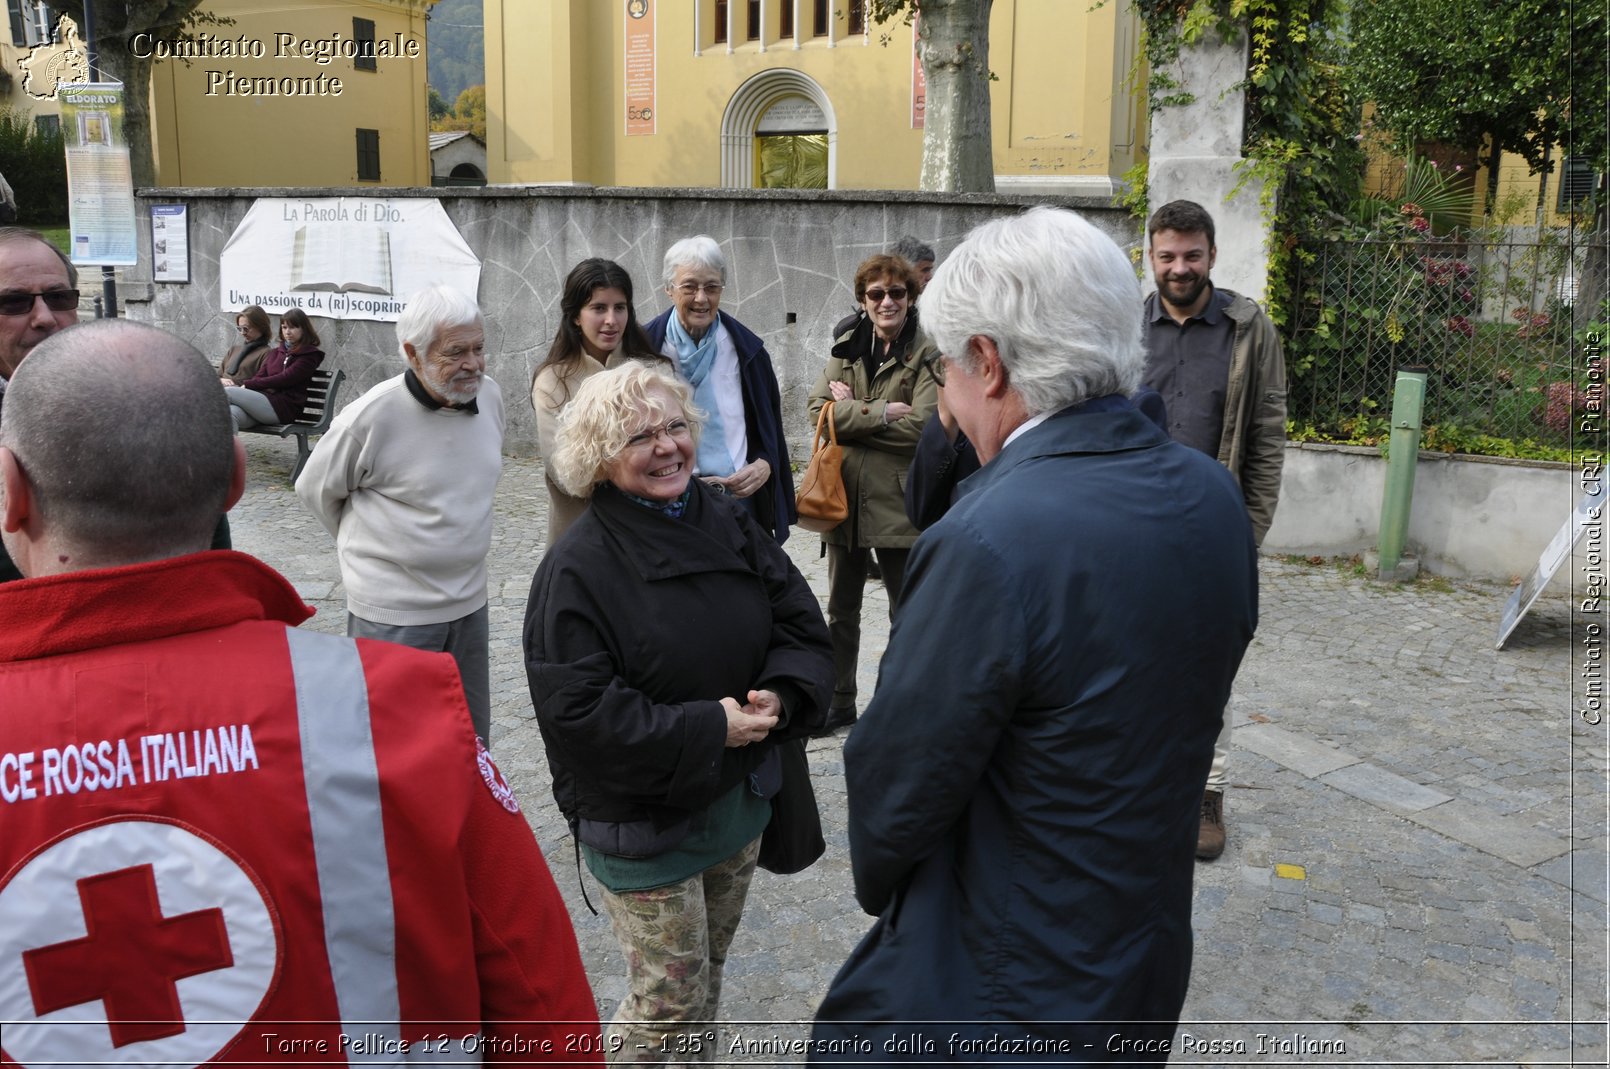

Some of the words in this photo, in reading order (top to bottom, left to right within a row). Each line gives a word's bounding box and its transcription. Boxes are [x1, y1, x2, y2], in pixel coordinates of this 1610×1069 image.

[66, 95, 117, 104] ELDORATO
[354, 202, 367, 221] di
[43, 739, 137, 797] ROSSA
[140, 724, 260, 784] ITALIANA
